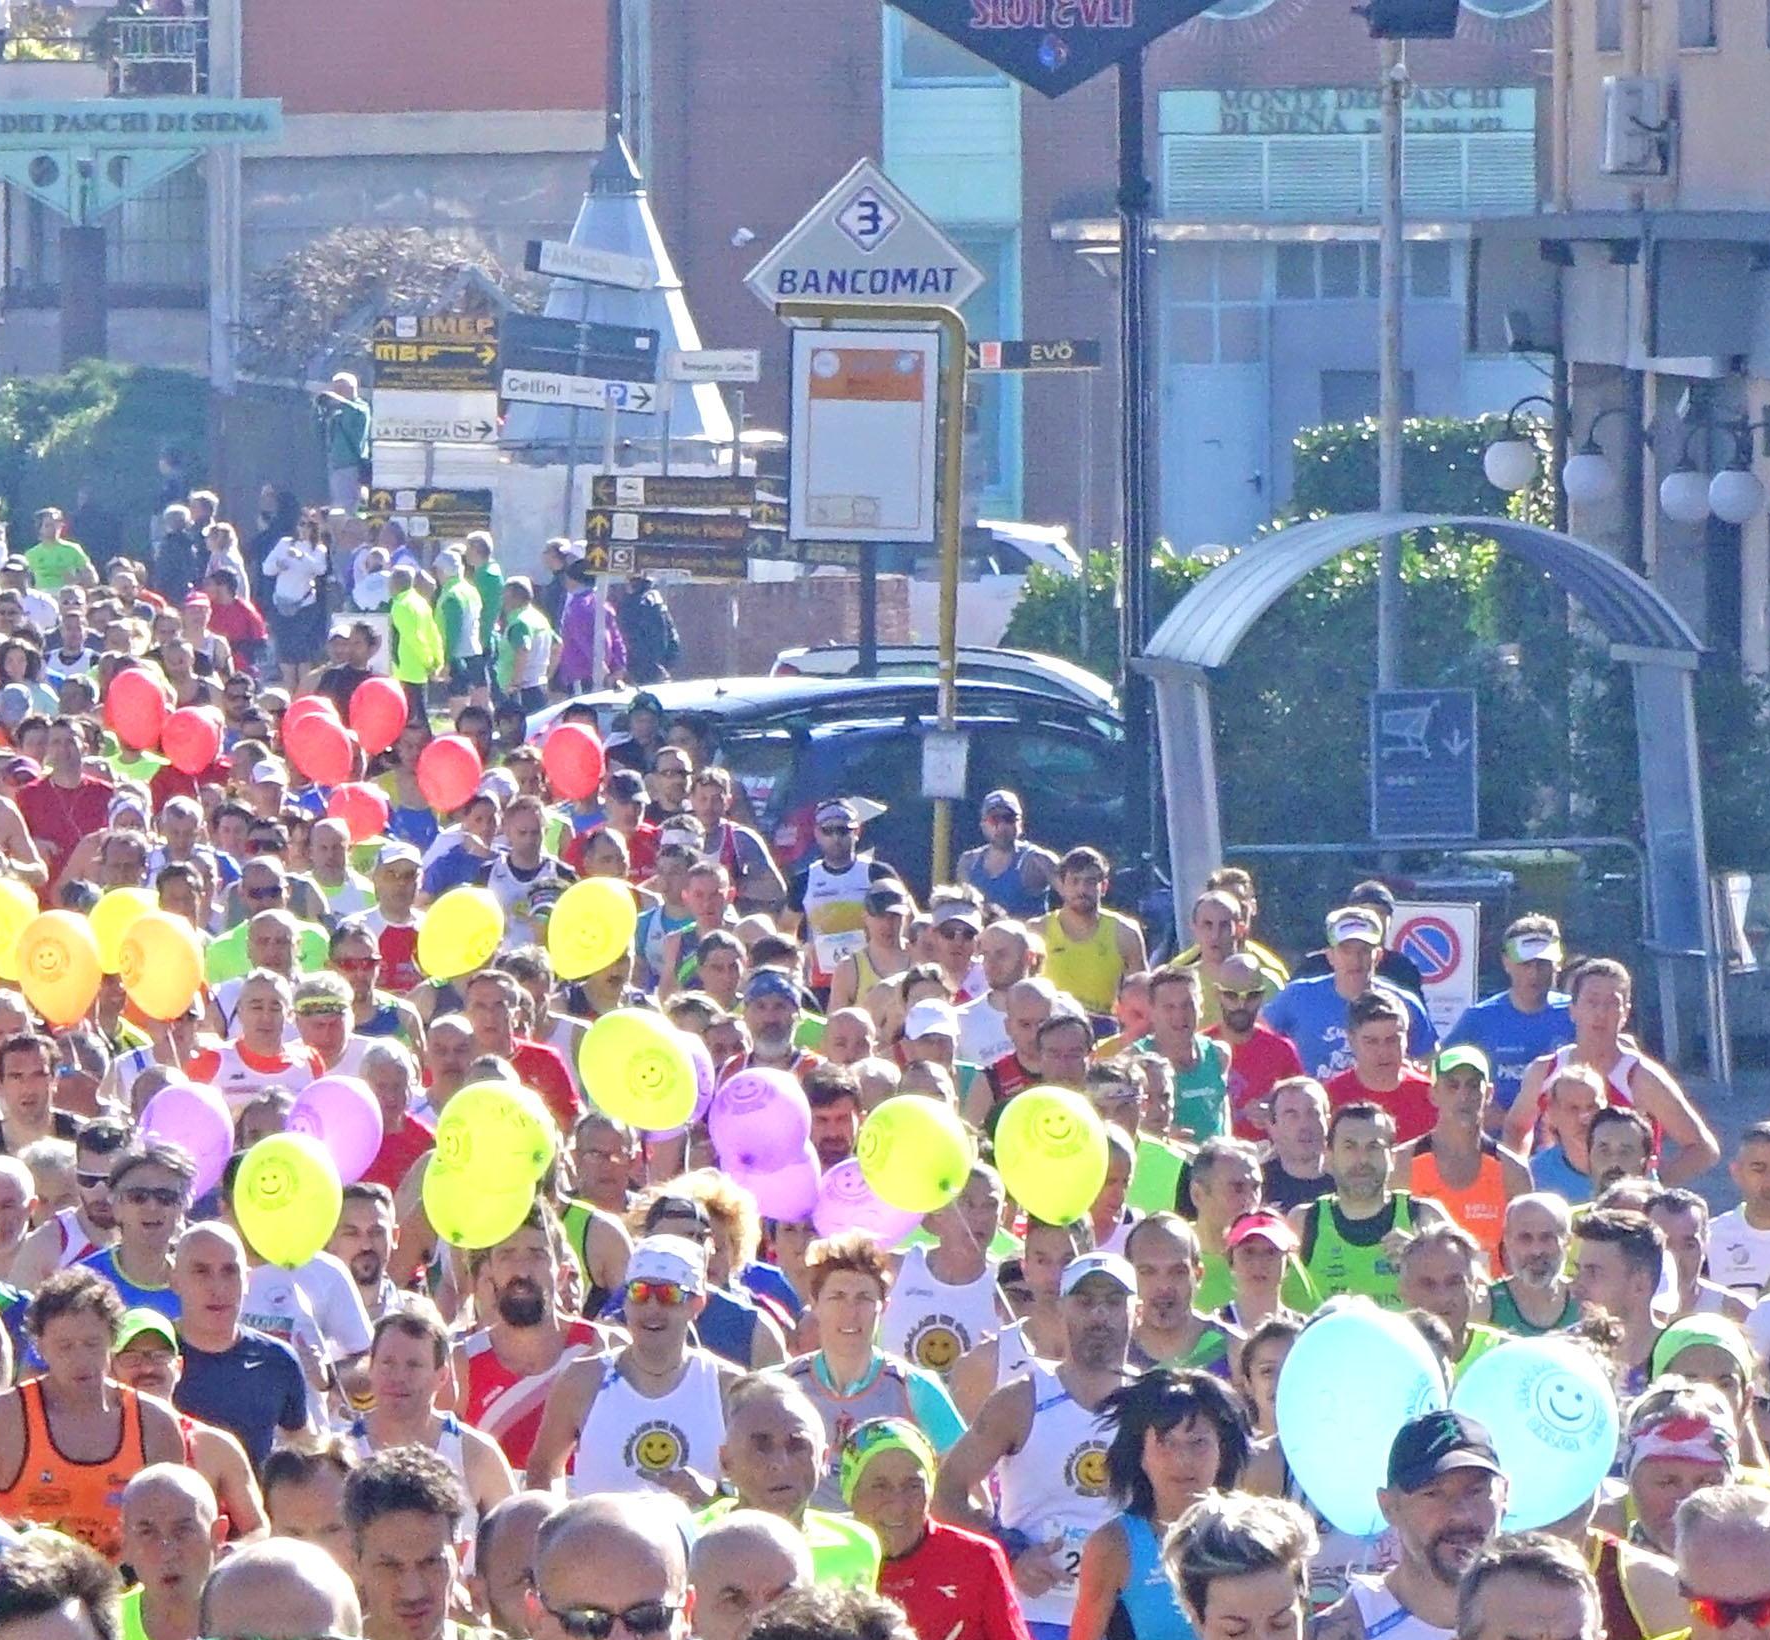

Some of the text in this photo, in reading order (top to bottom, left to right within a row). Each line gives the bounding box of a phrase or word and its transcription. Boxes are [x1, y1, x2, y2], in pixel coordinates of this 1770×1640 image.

[0, 113, 44, 134] DEI
[53, 113, 151, 133] PASCHI
[156, 113, 186, 133] DI
[192, 113, 269, 133] SIENA
[1262, 113, 1343, 131] SIENA
[778, 267, 958, 295] BANCOMAT
[508, 378, 562, 397] Cellini
[1065, 1552, 1080, 1576] 2
